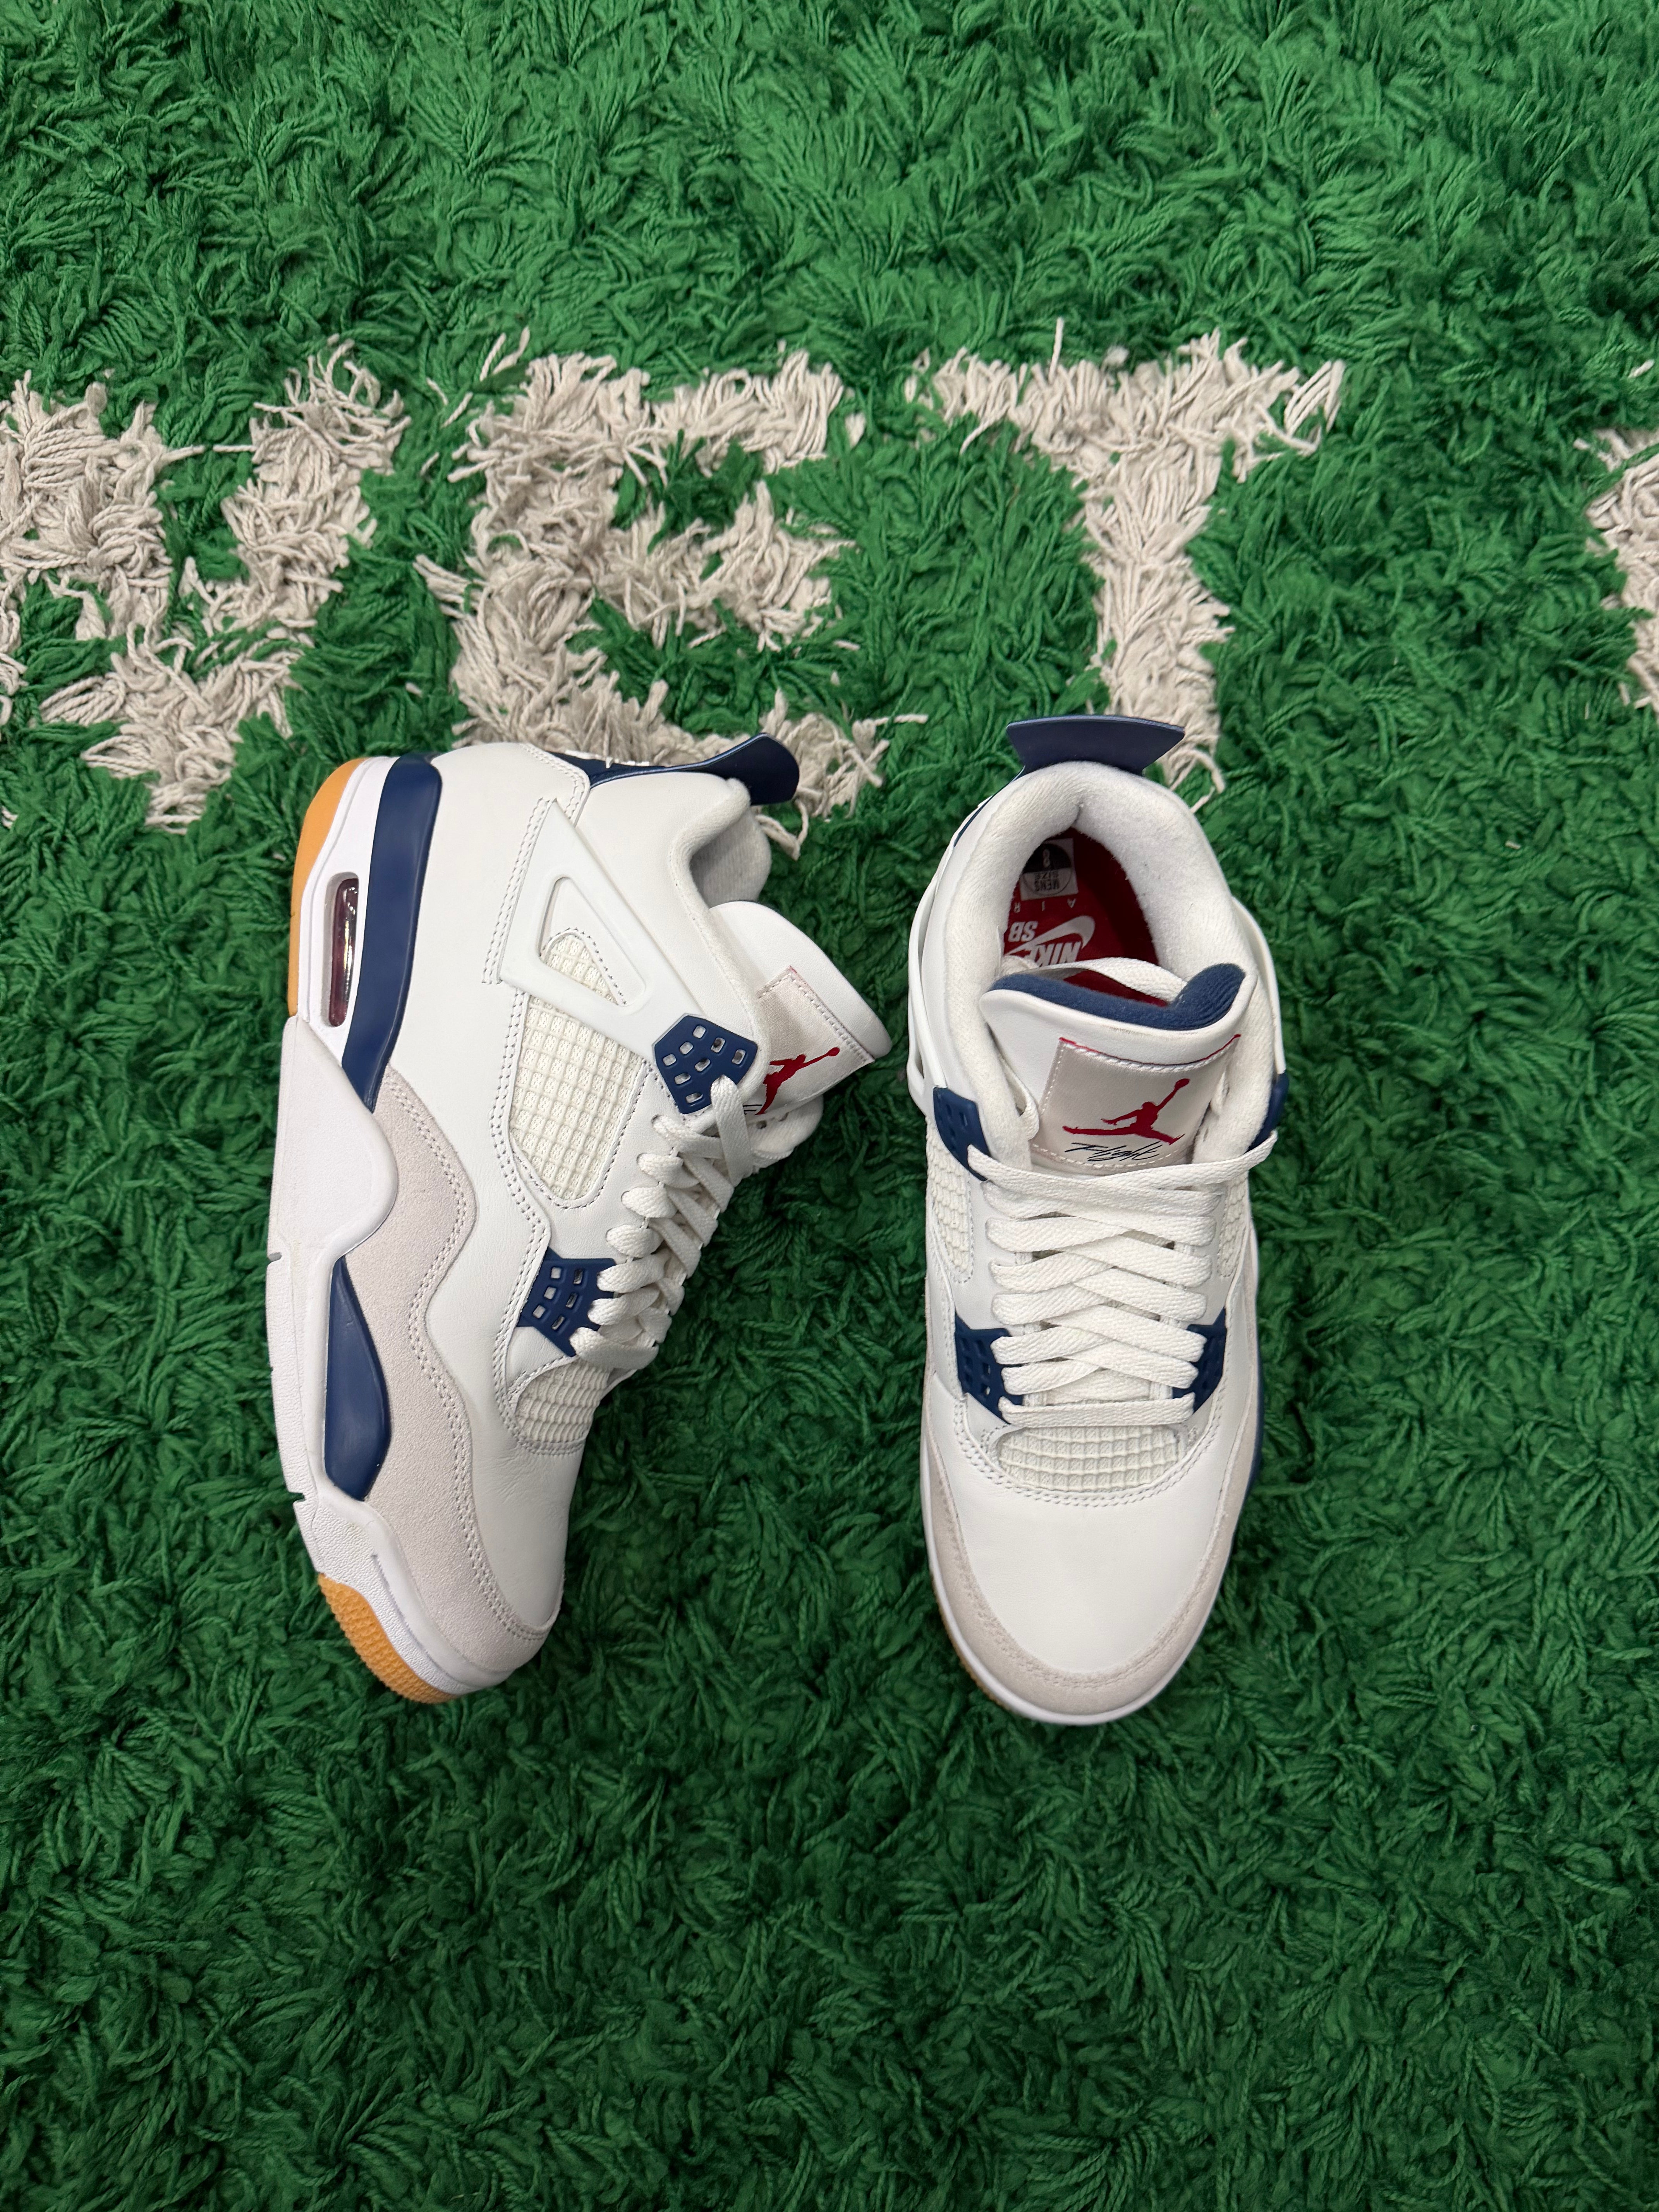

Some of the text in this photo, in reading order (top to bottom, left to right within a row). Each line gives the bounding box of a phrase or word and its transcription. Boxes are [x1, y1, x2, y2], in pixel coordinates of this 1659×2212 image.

[1034, 871, 1059, 880] SIZE
[1034, 879, 1060, 891] MENS
[1007, 921, 1038, 943] SB
[1064, 1140, 1163, 1162] Flight
